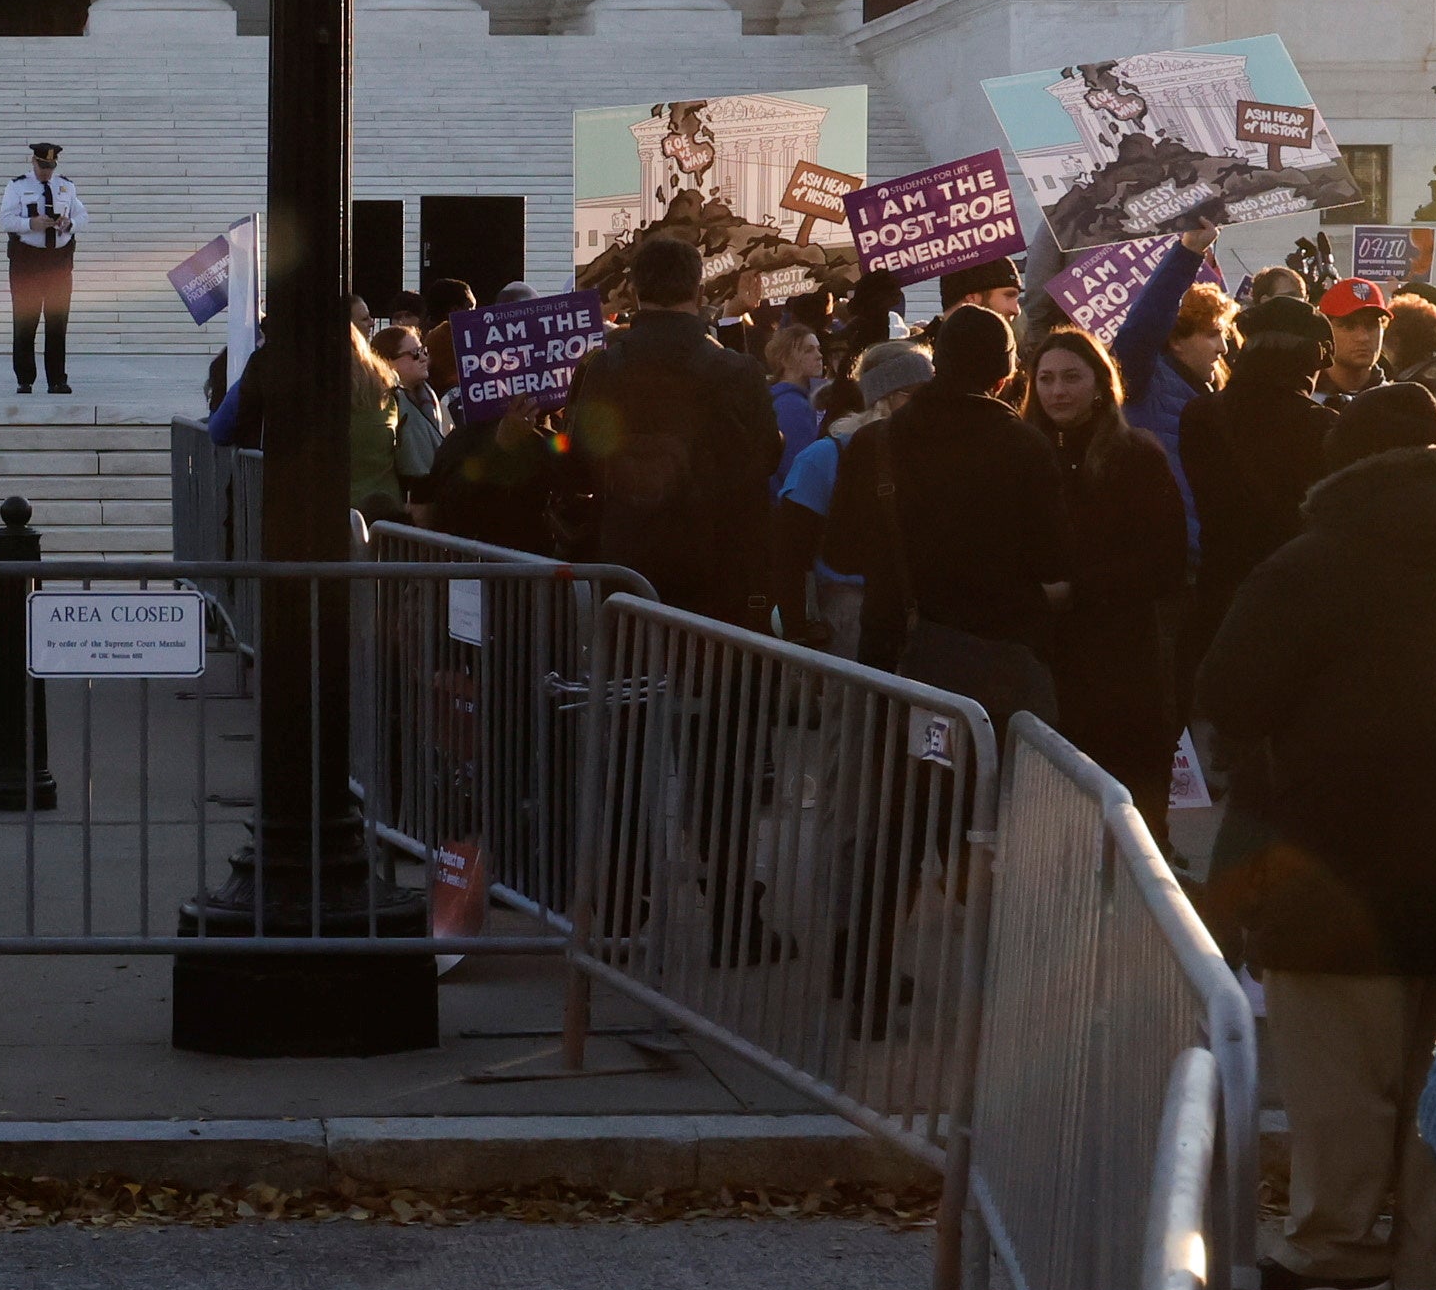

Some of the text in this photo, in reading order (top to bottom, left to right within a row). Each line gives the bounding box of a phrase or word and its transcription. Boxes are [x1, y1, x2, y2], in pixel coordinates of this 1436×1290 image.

[1088, 88, 1113, 107] ROE
[1244, 108, 1306, 124] ASH HEAP
[1244, 120, 1308, 140] of HISTORY
[665, 135, 689, 154] ROE
[682, 151, 710, 171] WADE
[797, 171, 852, 196] ASH HEAP
[890, 165, 970, 195] STUDENTS FOR LIFE
[791, 187, 846, 212] of HISTORY
[882, 169, 996, 220] AM THE
[1127, 183, 1177, 217] PLESSY
[1149, 183, 1214, 226] FERGUSON
[1229, 189, 1293, 217] DRED SCOTT
[1260, 197, 1307, 218] SANDFORD
[858, 189, 1011, 254] POST-ROE
[869, 217, 1016, 272] GENERATION
[1359, 238, 1406, 258] OHIO
[930, 261, 945, 272] LIFE
[1080, 246, 1113, 271] STUDENTS
[763, 278, 815, 299] SANDFORD
[772, 269, 804, 285] SCOTT
[1082, 259, 1118, 295] AM
[495, 301, 570, 321] STUDENTS LIFE
[485, 309, 592, 345] AM THE
[461, 331, 604, 378] POST-ROE
[49, 606, 184, 623] AREA CLOSED
[59, 640, 77, 648] order
[104, 641, 133, 650] Supreme
